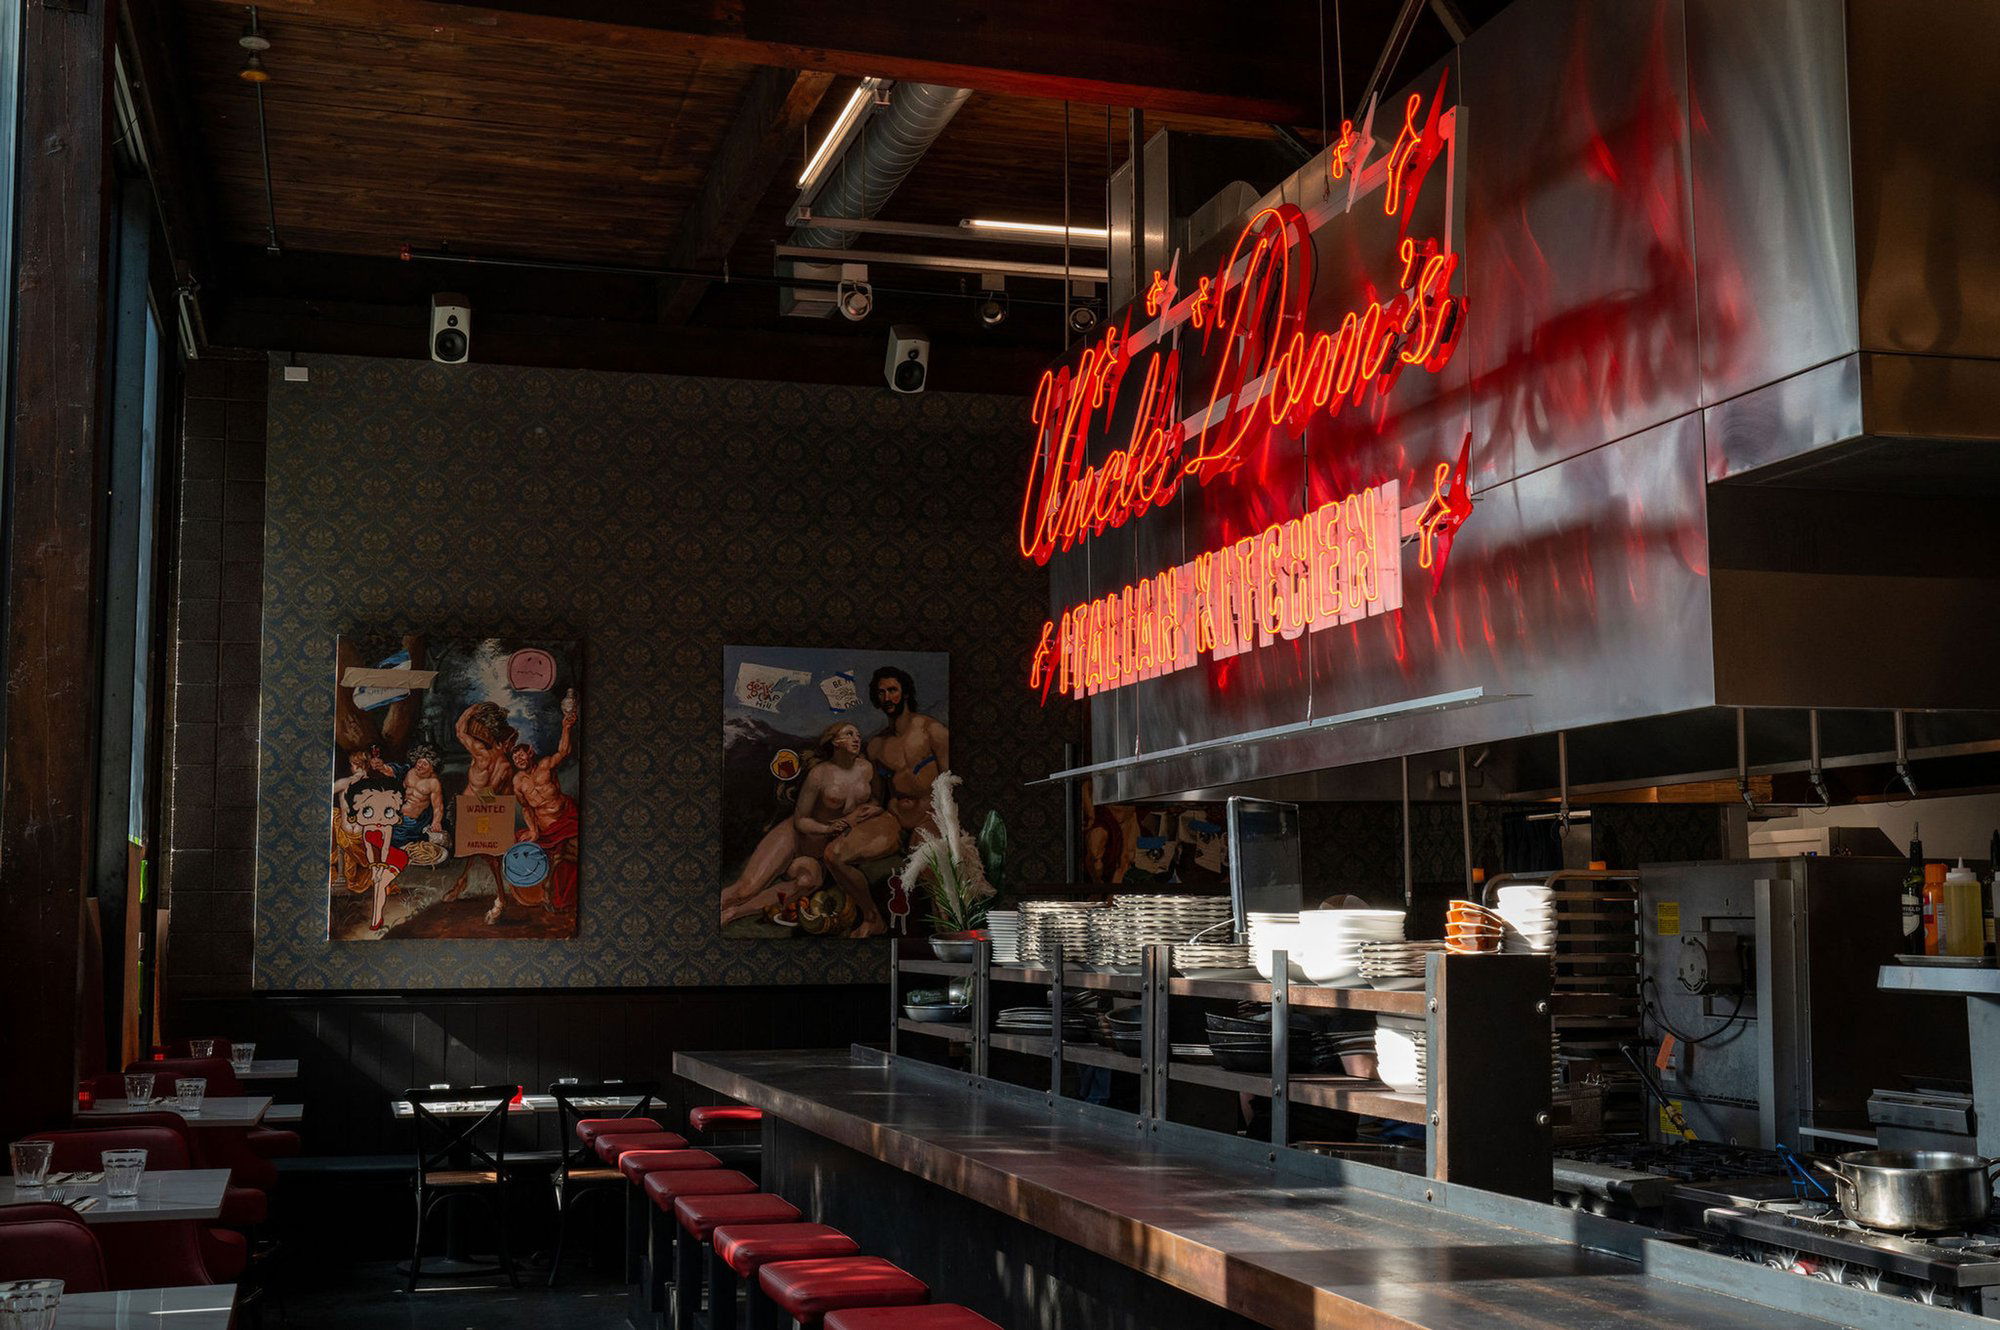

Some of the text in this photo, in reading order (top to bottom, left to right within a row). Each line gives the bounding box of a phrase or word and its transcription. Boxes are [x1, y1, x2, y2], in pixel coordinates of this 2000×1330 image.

[1020, 341, 1186, 567] Uncle
[1059, 484, 1391, 696] ITALIAN KITCHEN
[466, 804, 506, 814] WANTED
